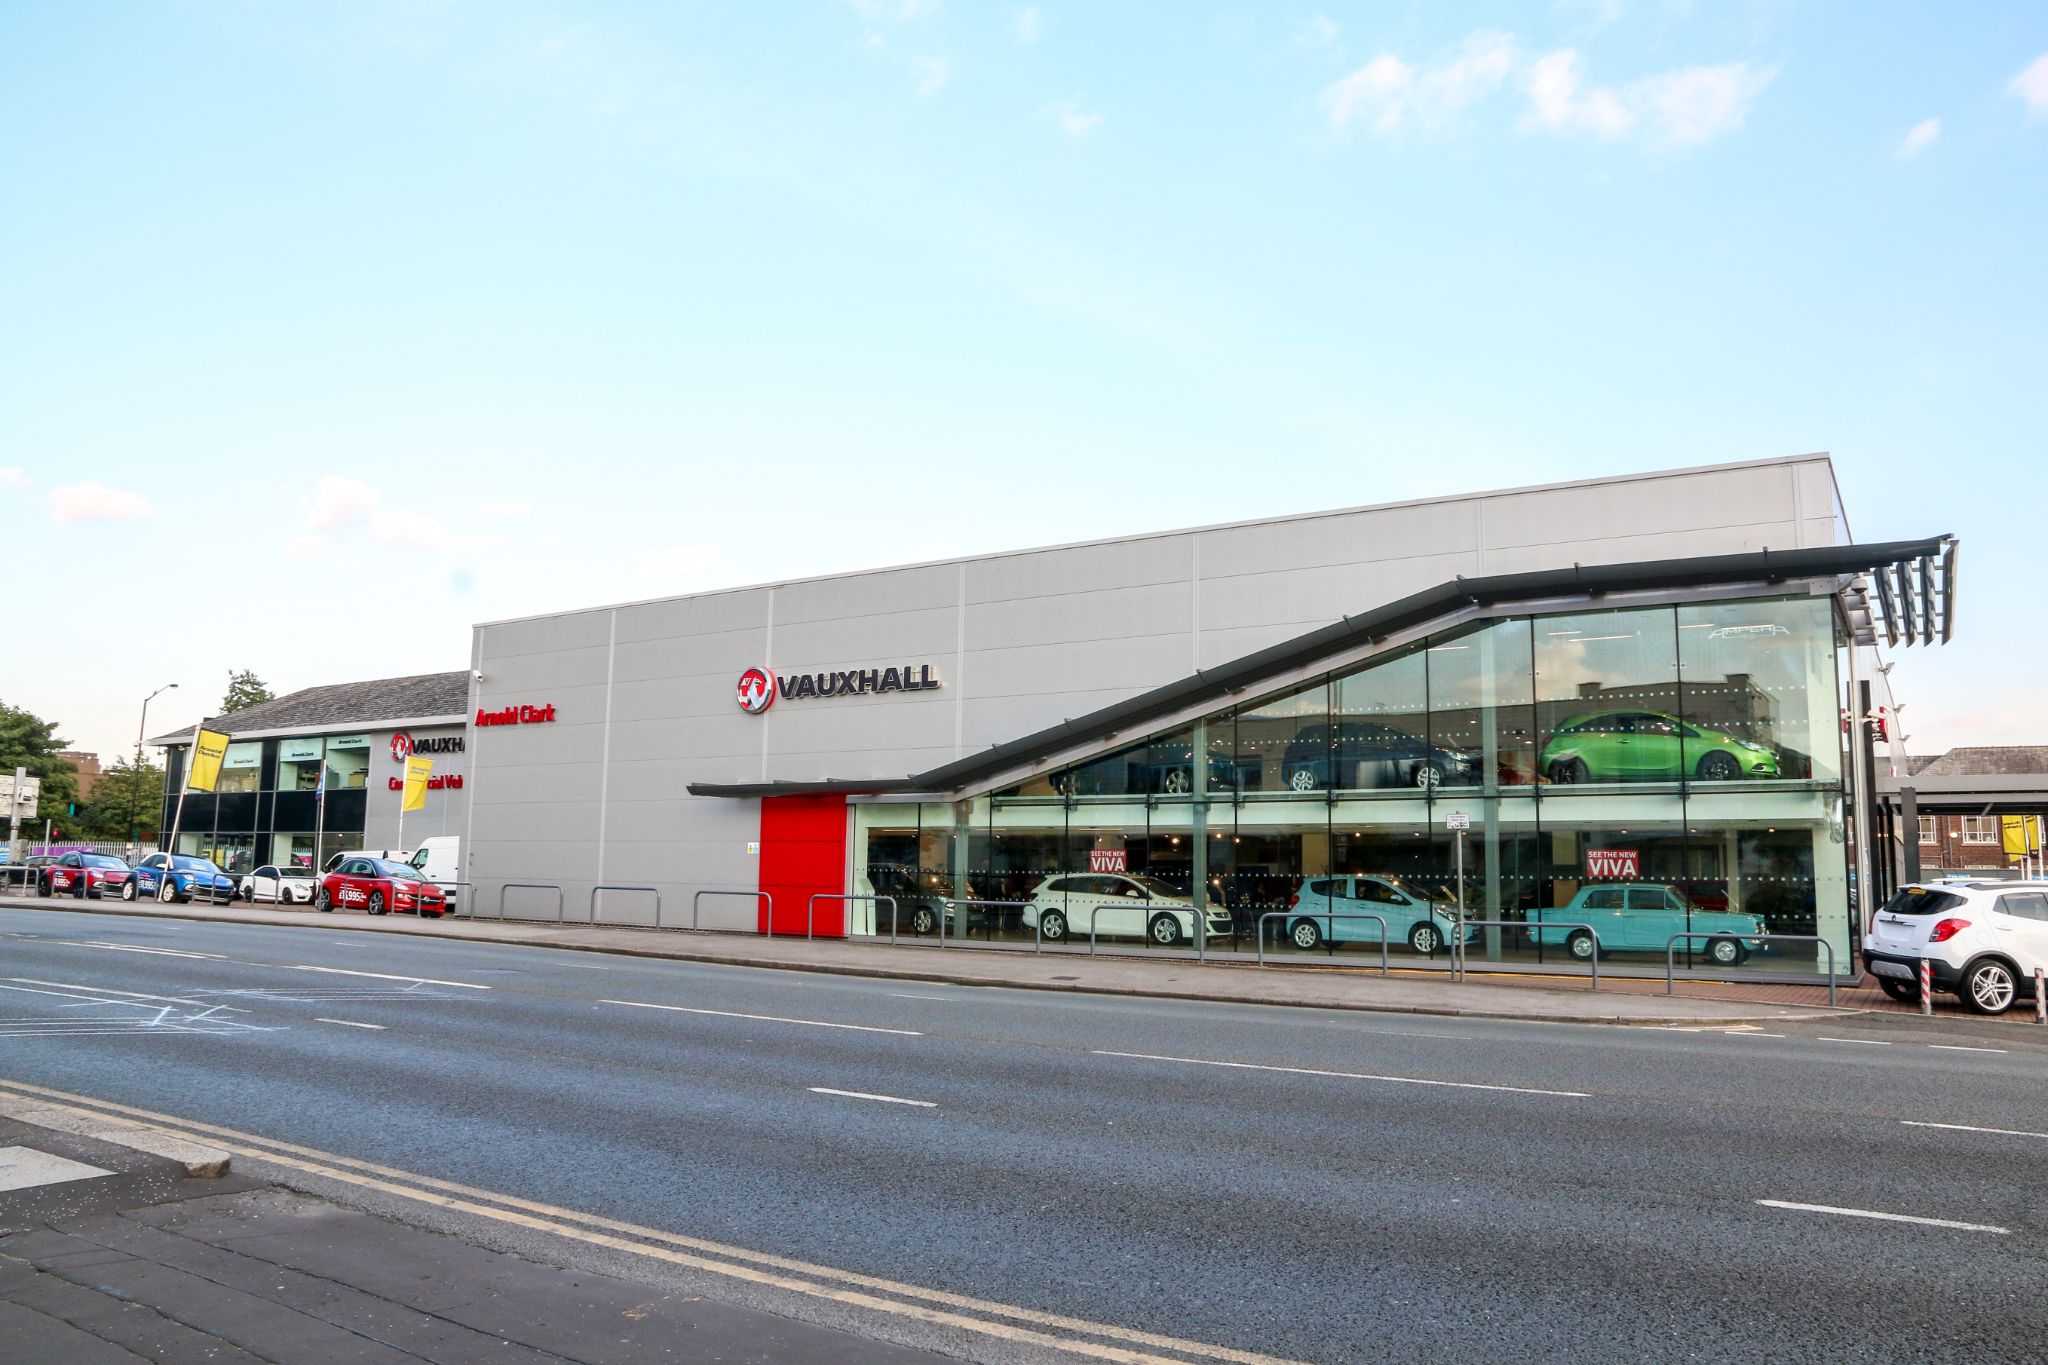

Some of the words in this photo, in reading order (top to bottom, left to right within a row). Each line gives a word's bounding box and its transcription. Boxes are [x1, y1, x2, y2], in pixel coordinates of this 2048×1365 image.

[777, 664, 940, 699] VAUXHALL
[475, 706, 518, 726] Arnold
[520, 703, 556, 723] Clark
[1091, 857, 1125, 871] VIVA
[1588, 859, 1637, 876] VIVA
